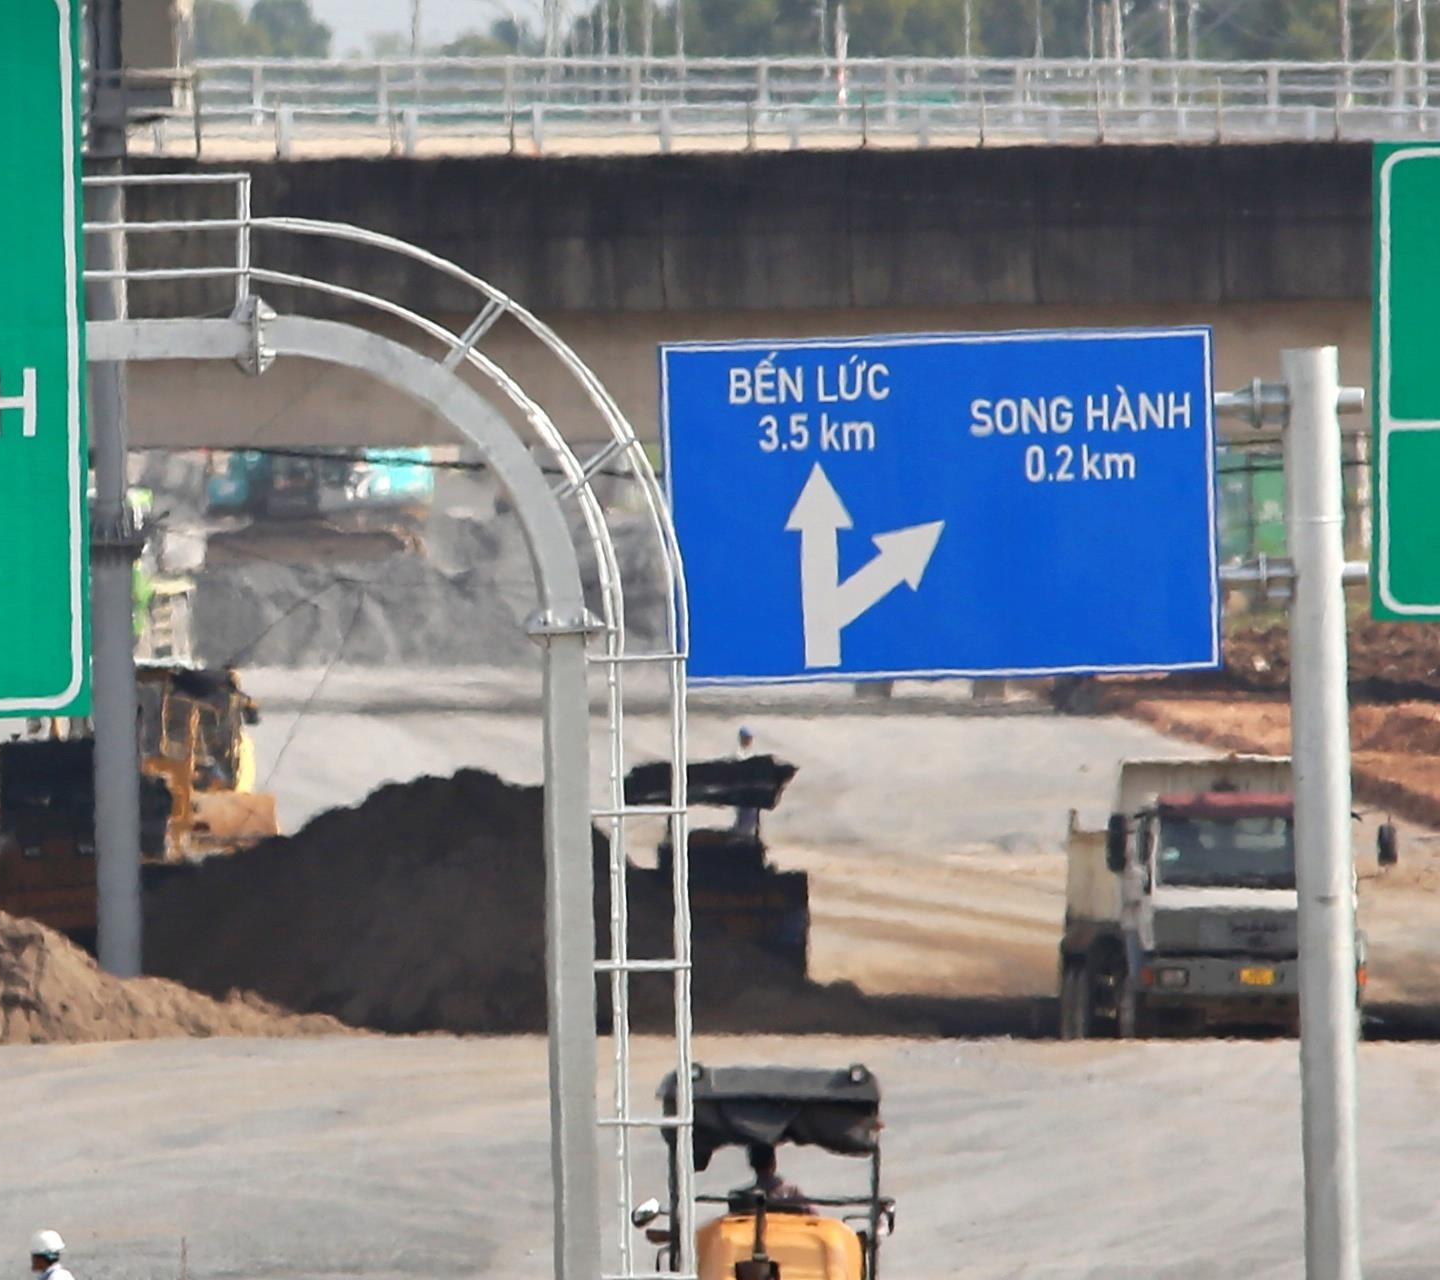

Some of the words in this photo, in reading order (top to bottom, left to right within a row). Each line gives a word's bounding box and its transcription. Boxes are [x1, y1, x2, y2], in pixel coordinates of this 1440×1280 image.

[728, 350, 804, 405] BẾN
[817, 354, 891, 403] LỨC
[758, 413, 810, 453] 3.5
[820, 413, 876, 452] km
[970, 396, 1074, 437] SONG
[1086, 385, 1192, 432] HÀNH
[1024, 444, 1075, 483] 0.2
[1081, 443, 1137, 480] km
